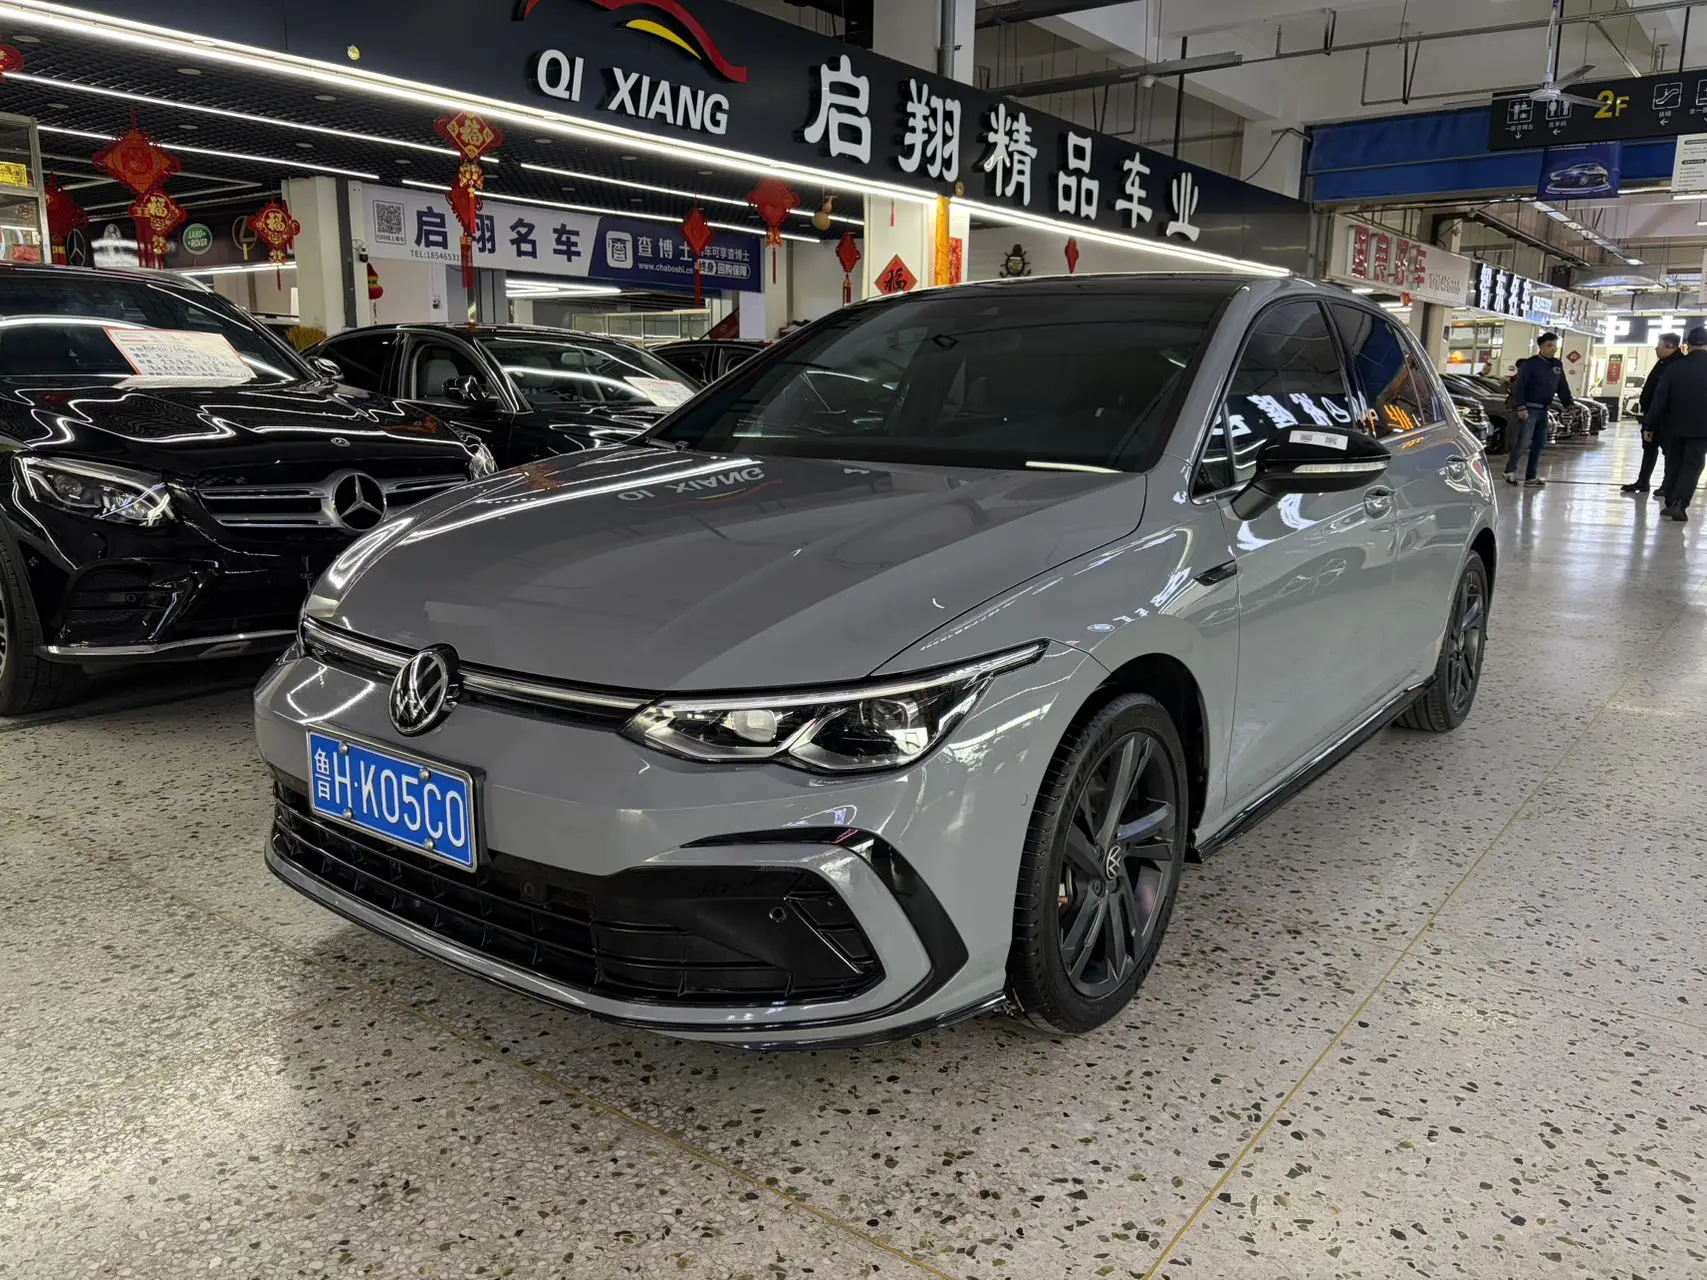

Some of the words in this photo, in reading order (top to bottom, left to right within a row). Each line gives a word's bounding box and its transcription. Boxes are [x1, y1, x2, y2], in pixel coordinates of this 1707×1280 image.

[537, 49, 584, 102] QI
[607, 66, 730, 135] XIANG
[1594, 90, 1630, 119] 2F
[804, 54, 1200, 242] 启翔精品车业
[410, 249, 460, 262] TEL:18546531
[637, 236, 692, 262] 查博士
[700, 246, 750, 262] 车可享查博士
[638, 263, 694, 275] www.chaboshi.cn
